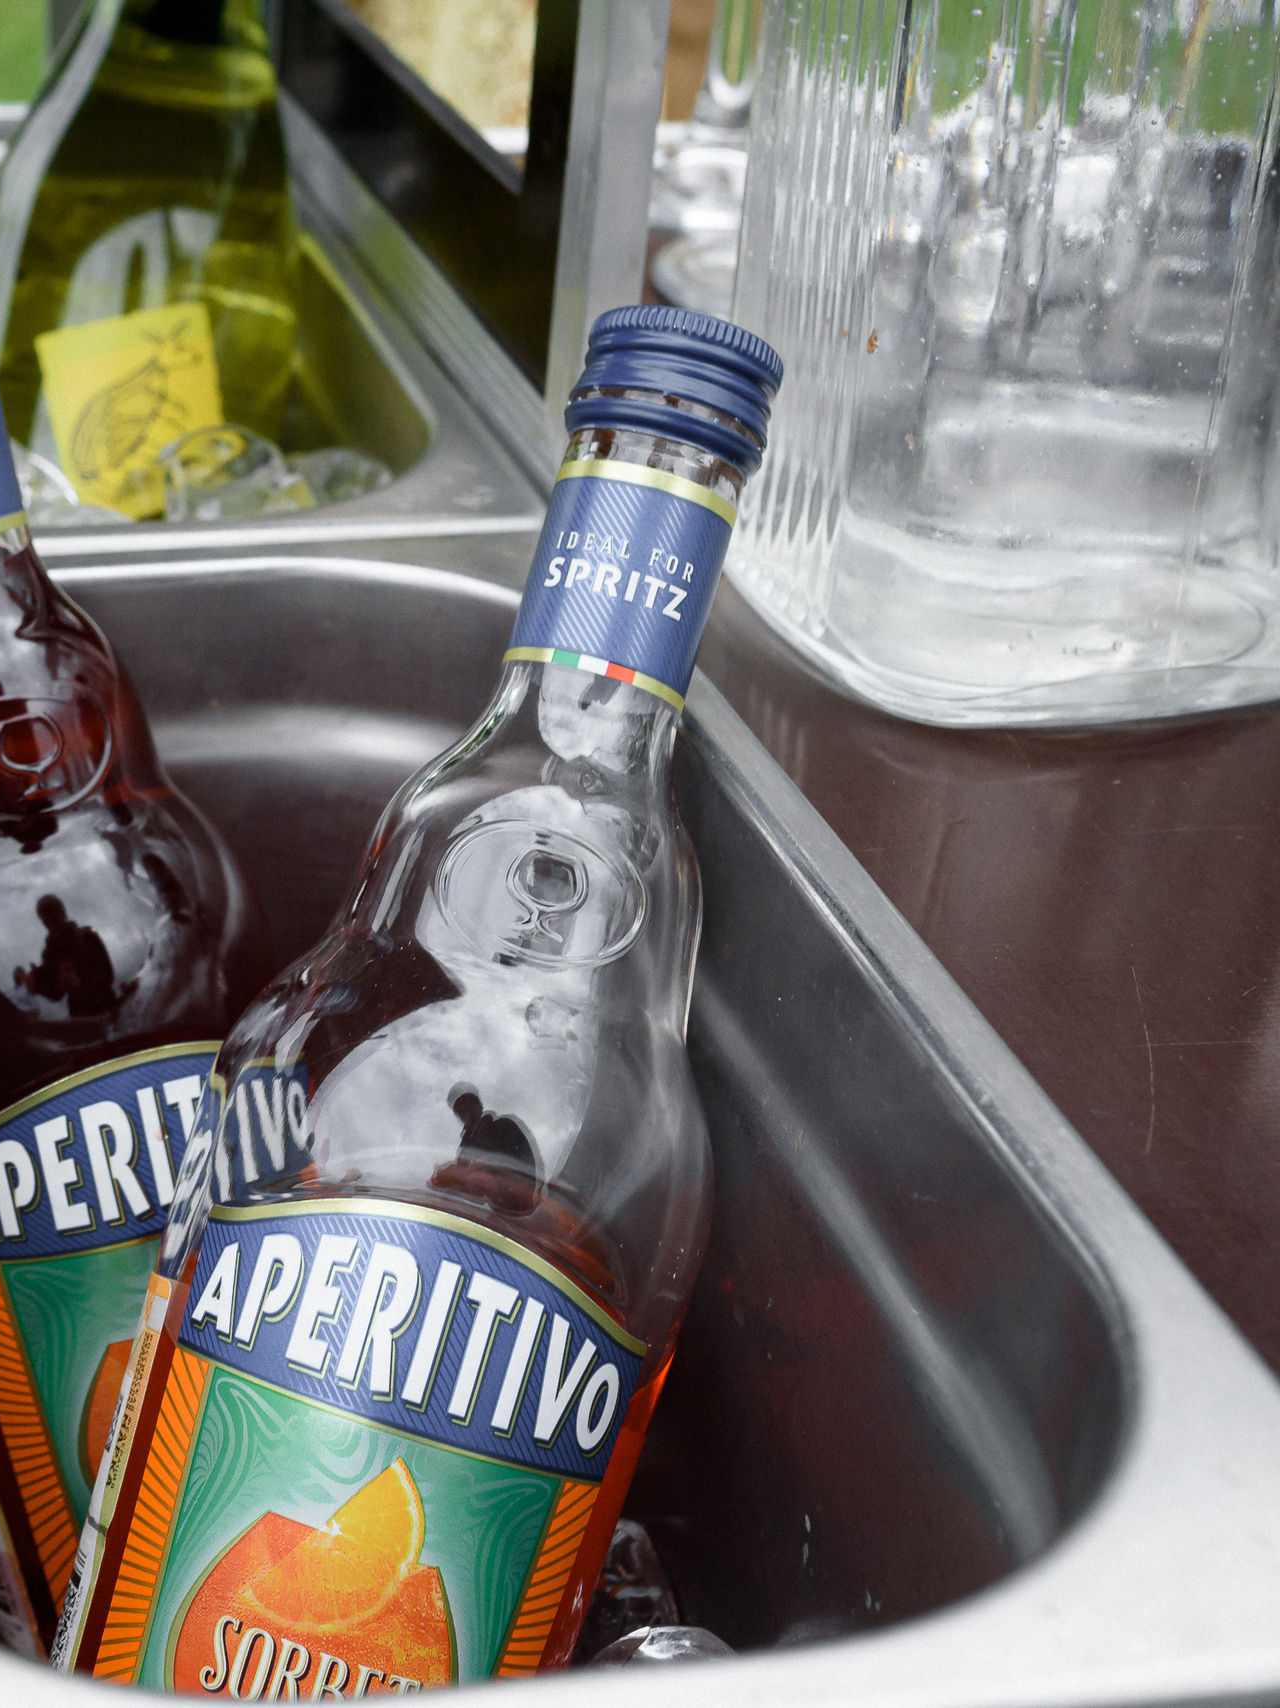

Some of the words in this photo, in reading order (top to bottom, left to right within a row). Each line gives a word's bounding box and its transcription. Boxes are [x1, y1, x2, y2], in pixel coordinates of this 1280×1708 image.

[543, 556, 688, 622] SPRITZ
[556, 531, 631, 560] IDEAL
[648, 548, 695, 583] FOR
[191, 1233, 619, 1451] APERITIVO
